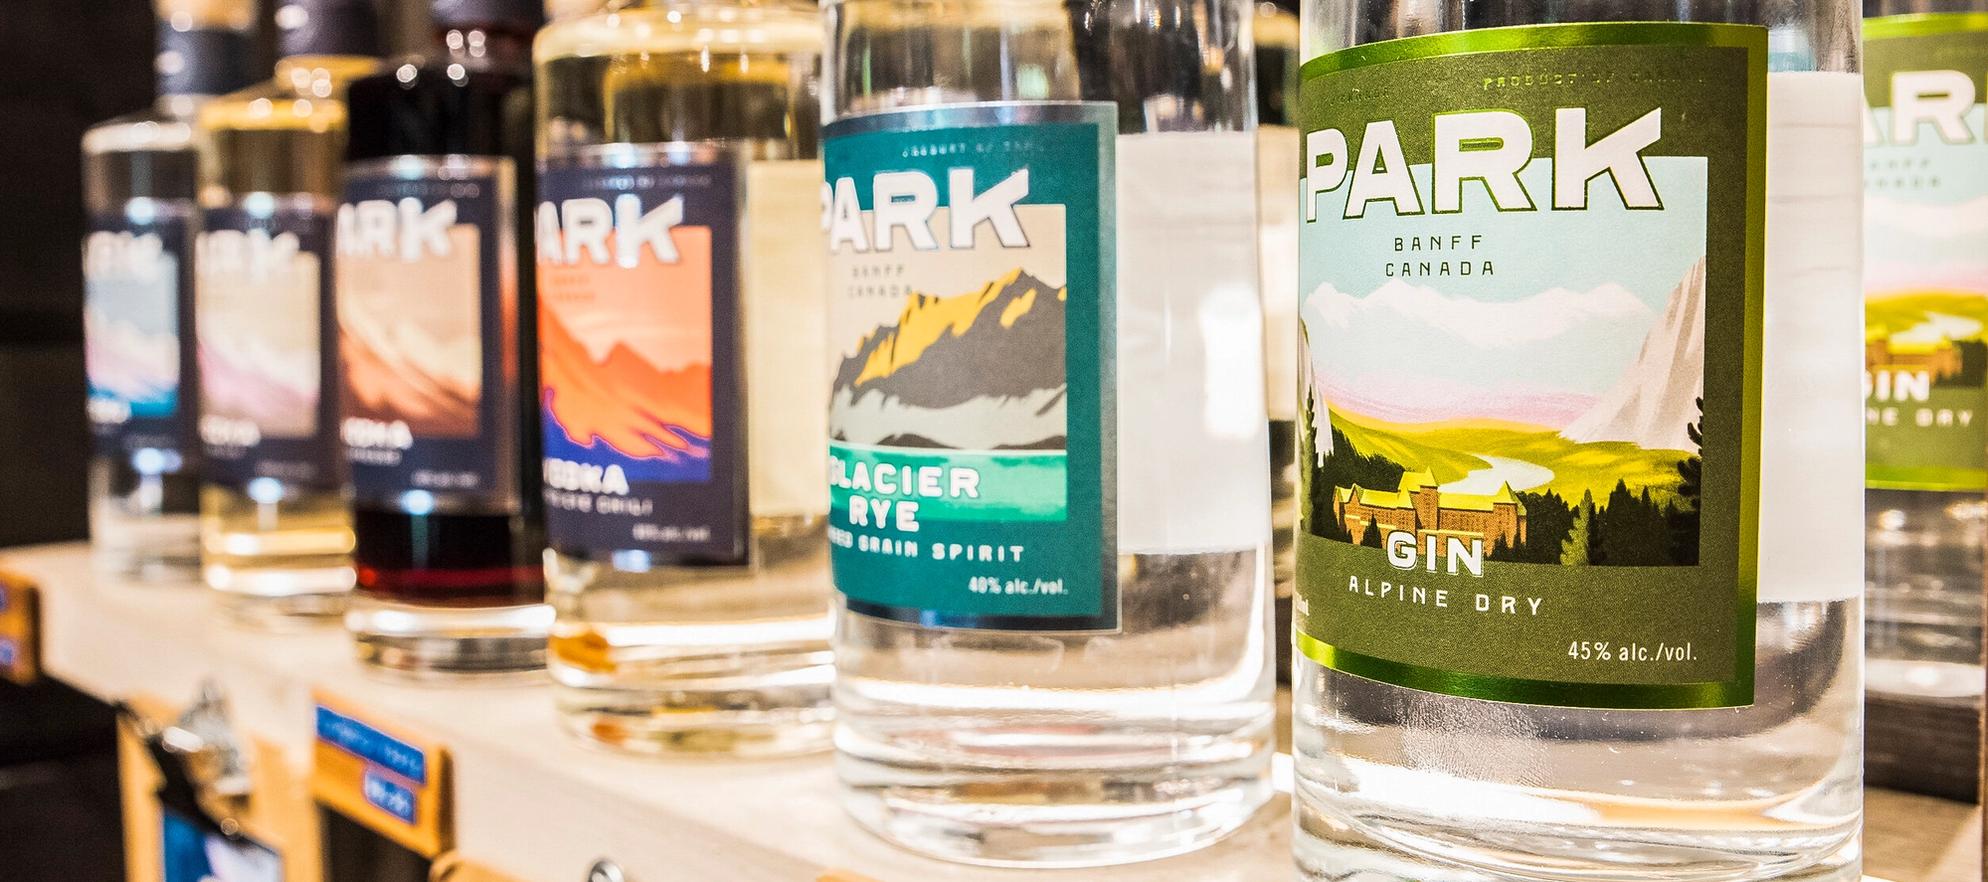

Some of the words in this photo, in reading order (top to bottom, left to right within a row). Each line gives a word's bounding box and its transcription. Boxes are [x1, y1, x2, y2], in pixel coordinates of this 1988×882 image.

[1304, 106, 1665, 223] PARK
[534, 193, 686, 268] ARK
[1394, 234, 1483, 252] BANFF
[1384, 260, 1495, 277] CANADA
[849, 494, 920, 532] RYE
[858, 534, 919, 558] GRAIN
[931, 542, 1024, 563] SPIRIT
[1386, 530, 1484, 577] GIN
[1348, 575, 1449, 608] ALPINE
[1475, 593, 1543, 616] DRY
[1568, 640, 1612, 660] 45%
[1619, 642, 1698, 661] alc./vol.
